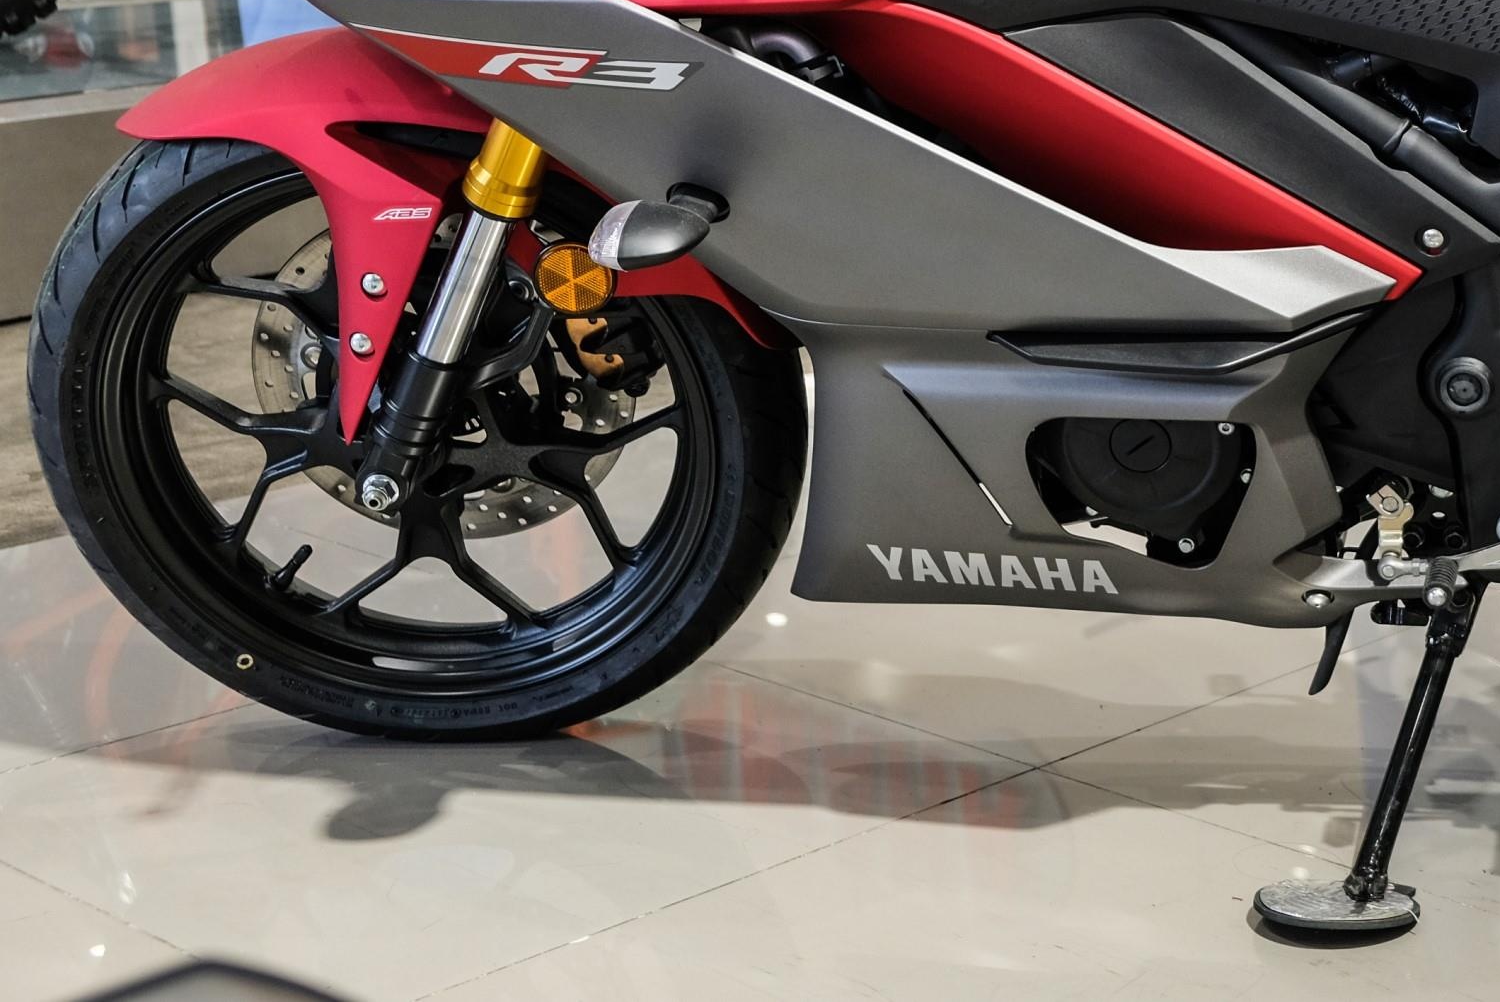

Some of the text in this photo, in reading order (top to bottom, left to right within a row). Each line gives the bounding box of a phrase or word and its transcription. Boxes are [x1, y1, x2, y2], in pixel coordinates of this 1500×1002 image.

[478, 52, 692, 91] R3
[374, 207, 432, 220] ABS
[866, 544, 1119, 595] YAMAHA
